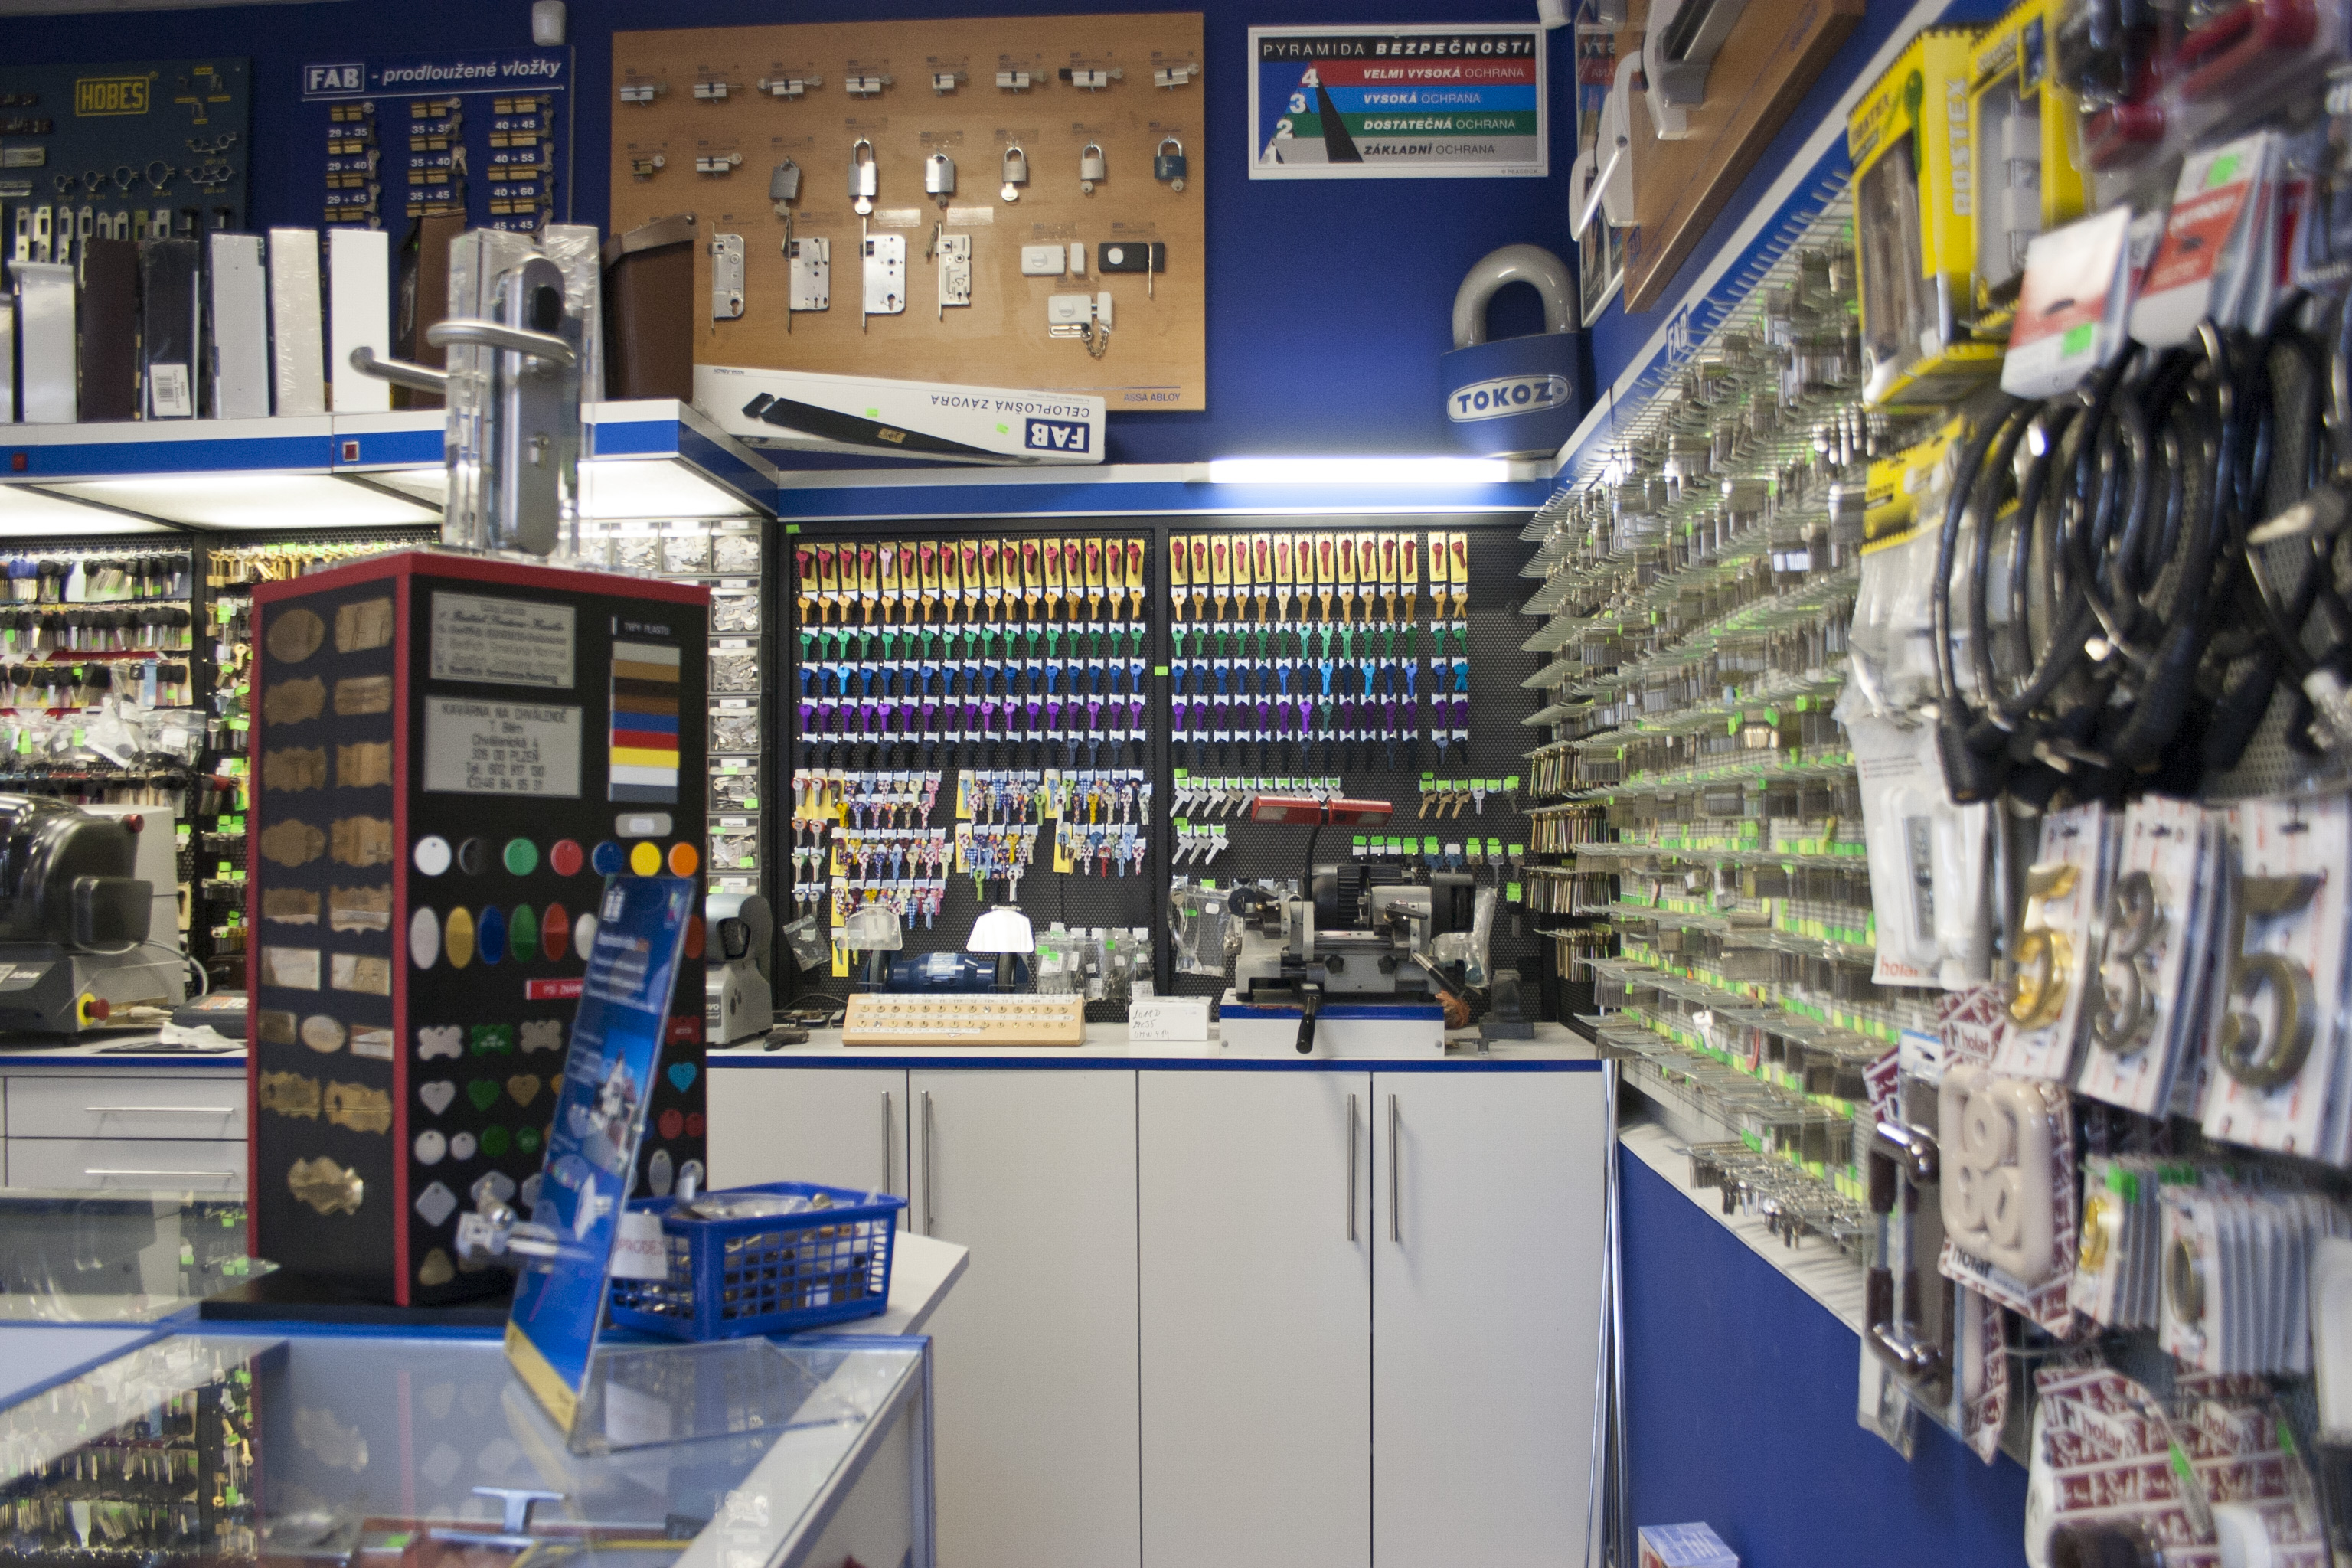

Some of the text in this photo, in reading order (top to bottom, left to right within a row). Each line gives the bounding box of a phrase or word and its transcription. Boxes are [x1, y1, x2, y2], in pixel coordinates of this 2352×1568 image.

[1263, 40, 1531, 56] PYRAMIDA BEZPEČNOSTI
[310, 68, 360, 90] FAB
[383, 62, 497, 86] prodloužené
[502, 59, 561, 78] vložky
[1301, 67, 1524, 87] 4 VELMI VYSOKÁ OCHRANA
[80, 83, 144, 111] HOBES
[1289, 93, 1481, 113] 3 VYSOKÁ OCHRANA
[411, 126, 424, 134] 35
[495, 122, 508, 130] 40
[1276, 117, 1515, 139] 2 DOSTATEČNÁ OCHRANA
[329, 129, 341, 138] 29
[1364, 143, 1432, 155] ZÁKLADNÍ
[1436, 145, 1495, 155] OCHRANA
[411, 158, 424, 167] 35
[495, 155, 508, 163] 40
[328, 162, 341, 171] 29
[410, 192, 423, 201] 35
[494, 188, 507, 197] 40
[327, 196, 340, 204] 29
[493, 221, 506, 230] 45
[1124, 393, 1180, 402] ASSA ABLOY
[1457, 383, 1553, 413] TOKOZ
[931, 395, 1090, 418] CELOPLOŠNÁ ZÁVORA
[1031, 423, 1085, 449] FAB
[1962, 1029, 1989, 1056] holar
